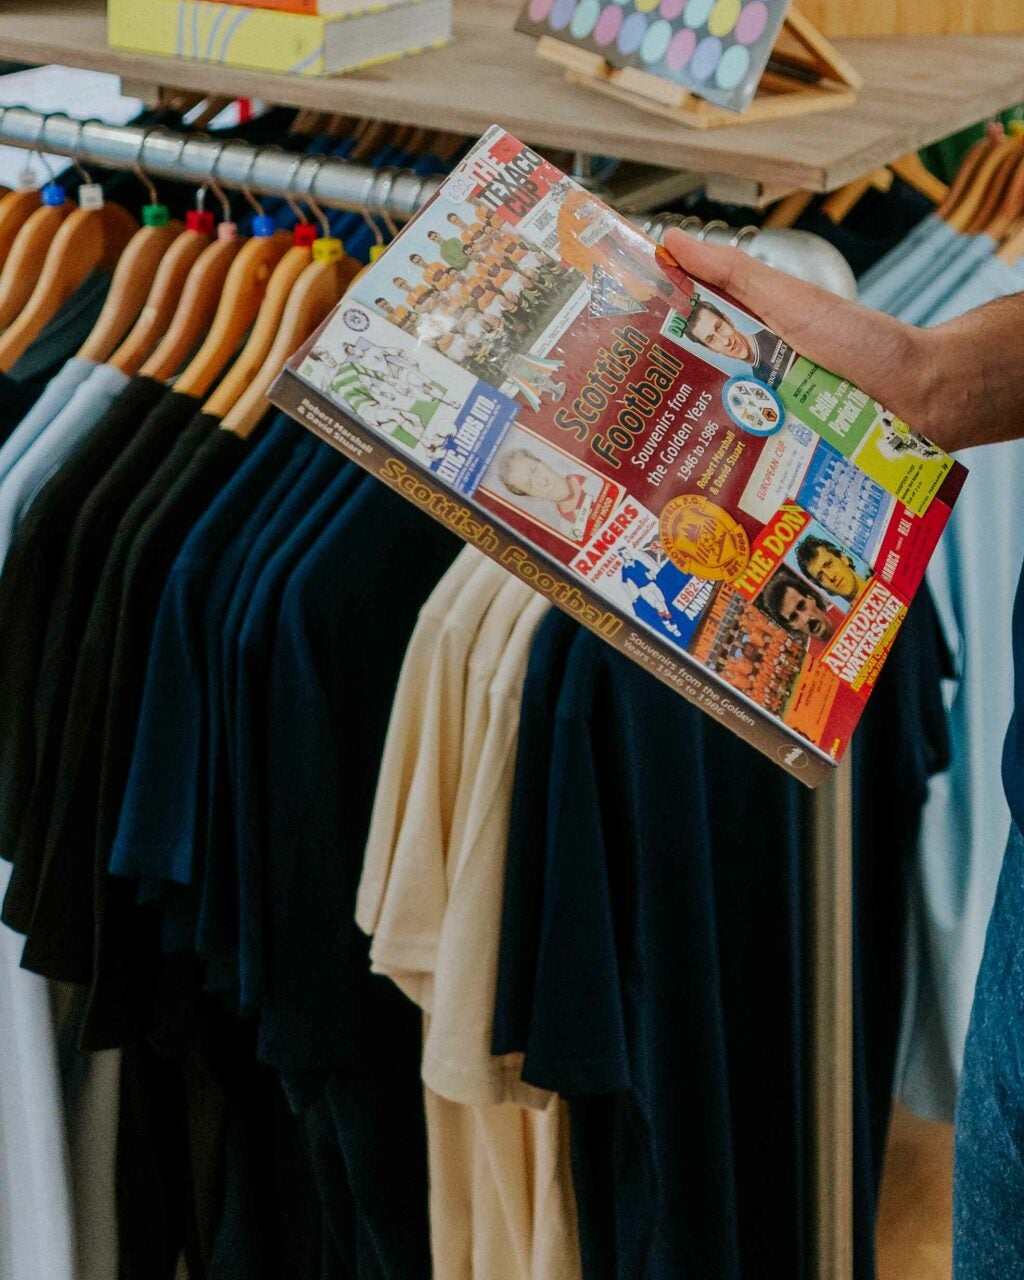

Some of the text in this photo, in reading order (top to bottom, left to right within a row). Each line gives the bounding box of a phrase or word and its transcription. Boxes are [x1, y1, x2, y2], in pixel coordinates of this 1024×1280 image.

[477, 147, 542, 209] TEXACO
[503, 178, 545, 217] CUP
[552, 320, 649, 441] Scottish
[588, 345, 683, 467] Football
[300, 398, 372, 454] Robert Marshall
[305, 411, 333, 435] David
[332, 430, 363, 457] Stuart
[453, 415, 483, 451] LEEDS
[631, 381, 693, 468] Souvenirs from
[646, 388, 712, 487] the Golden Years
[676, 419, 719, 481] 1946 to 1986
[696, 430, 735, 489] Robert Marshall
[709, 440, 746, 495] & David Stuart
[757, 440, 786, 499] EUROPEAN CUP
[600, 497, 613, 516] HOOD
[897, 517, 911, 537] REAL
[381, 457, 621, 638] Scottish Football
[575, 504, 638, 574] RANGERS
[590, 553, 616, 582] FOOTBALL
[606, 559, 621, 577] CLUB
[734, 550, 775, 596] THE
[824, 584, 889, 674] ABERDEEN
[840, 596, 902, 682] WATERSCHEI
[622, 640, 649, 662] Years
[655, 664, 685, 687] 1946
[683, 684, 697, 696] to
[696, 692, 725, 716] 1986
[628, 632, 756, 726] Souvenirs from the Golden
